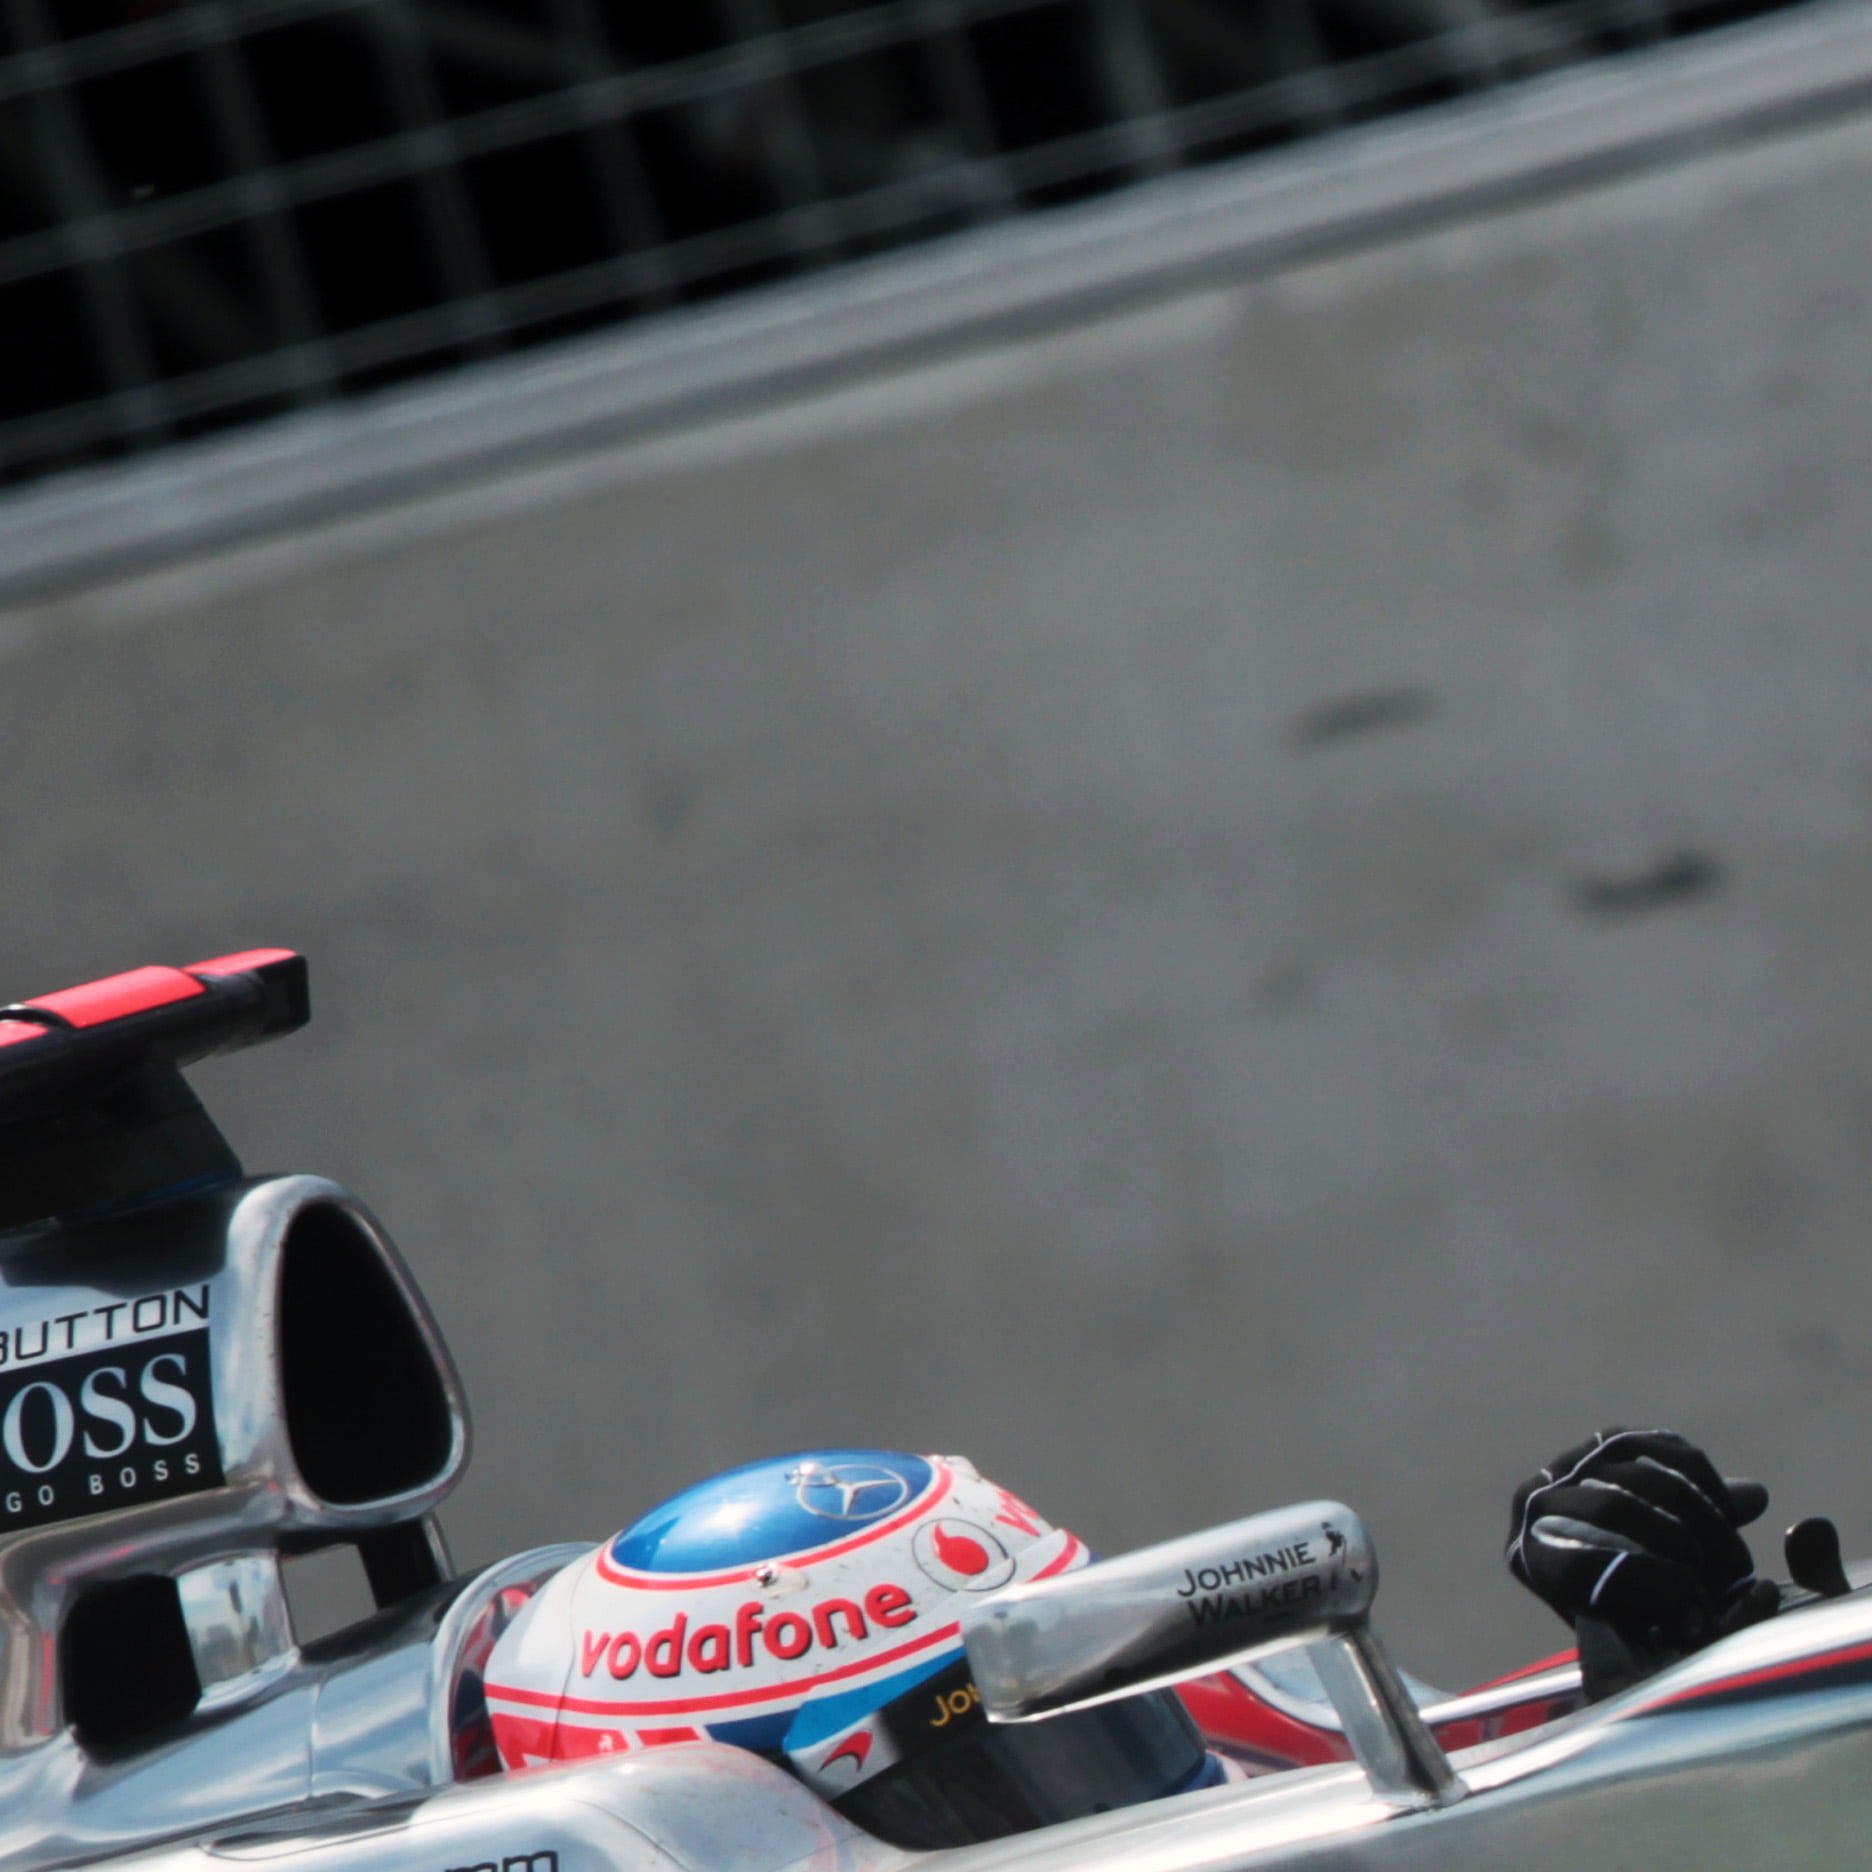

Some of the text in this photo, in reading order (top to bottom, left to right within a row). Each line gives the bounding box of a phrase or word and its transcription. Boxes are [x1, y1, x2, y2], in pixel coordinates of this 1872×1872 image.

[0, 1283, 210, 1366] UTTON
[3, 1353, 196, 1474] OSS
[5, 1452, 201, 1513] GO BOSS
[1177, 1541, 1317, 1598] JOHNNIE
[1188, 1575, 1322, 1627] WALKER
[581, 1583, 917, 1681] vodafone
